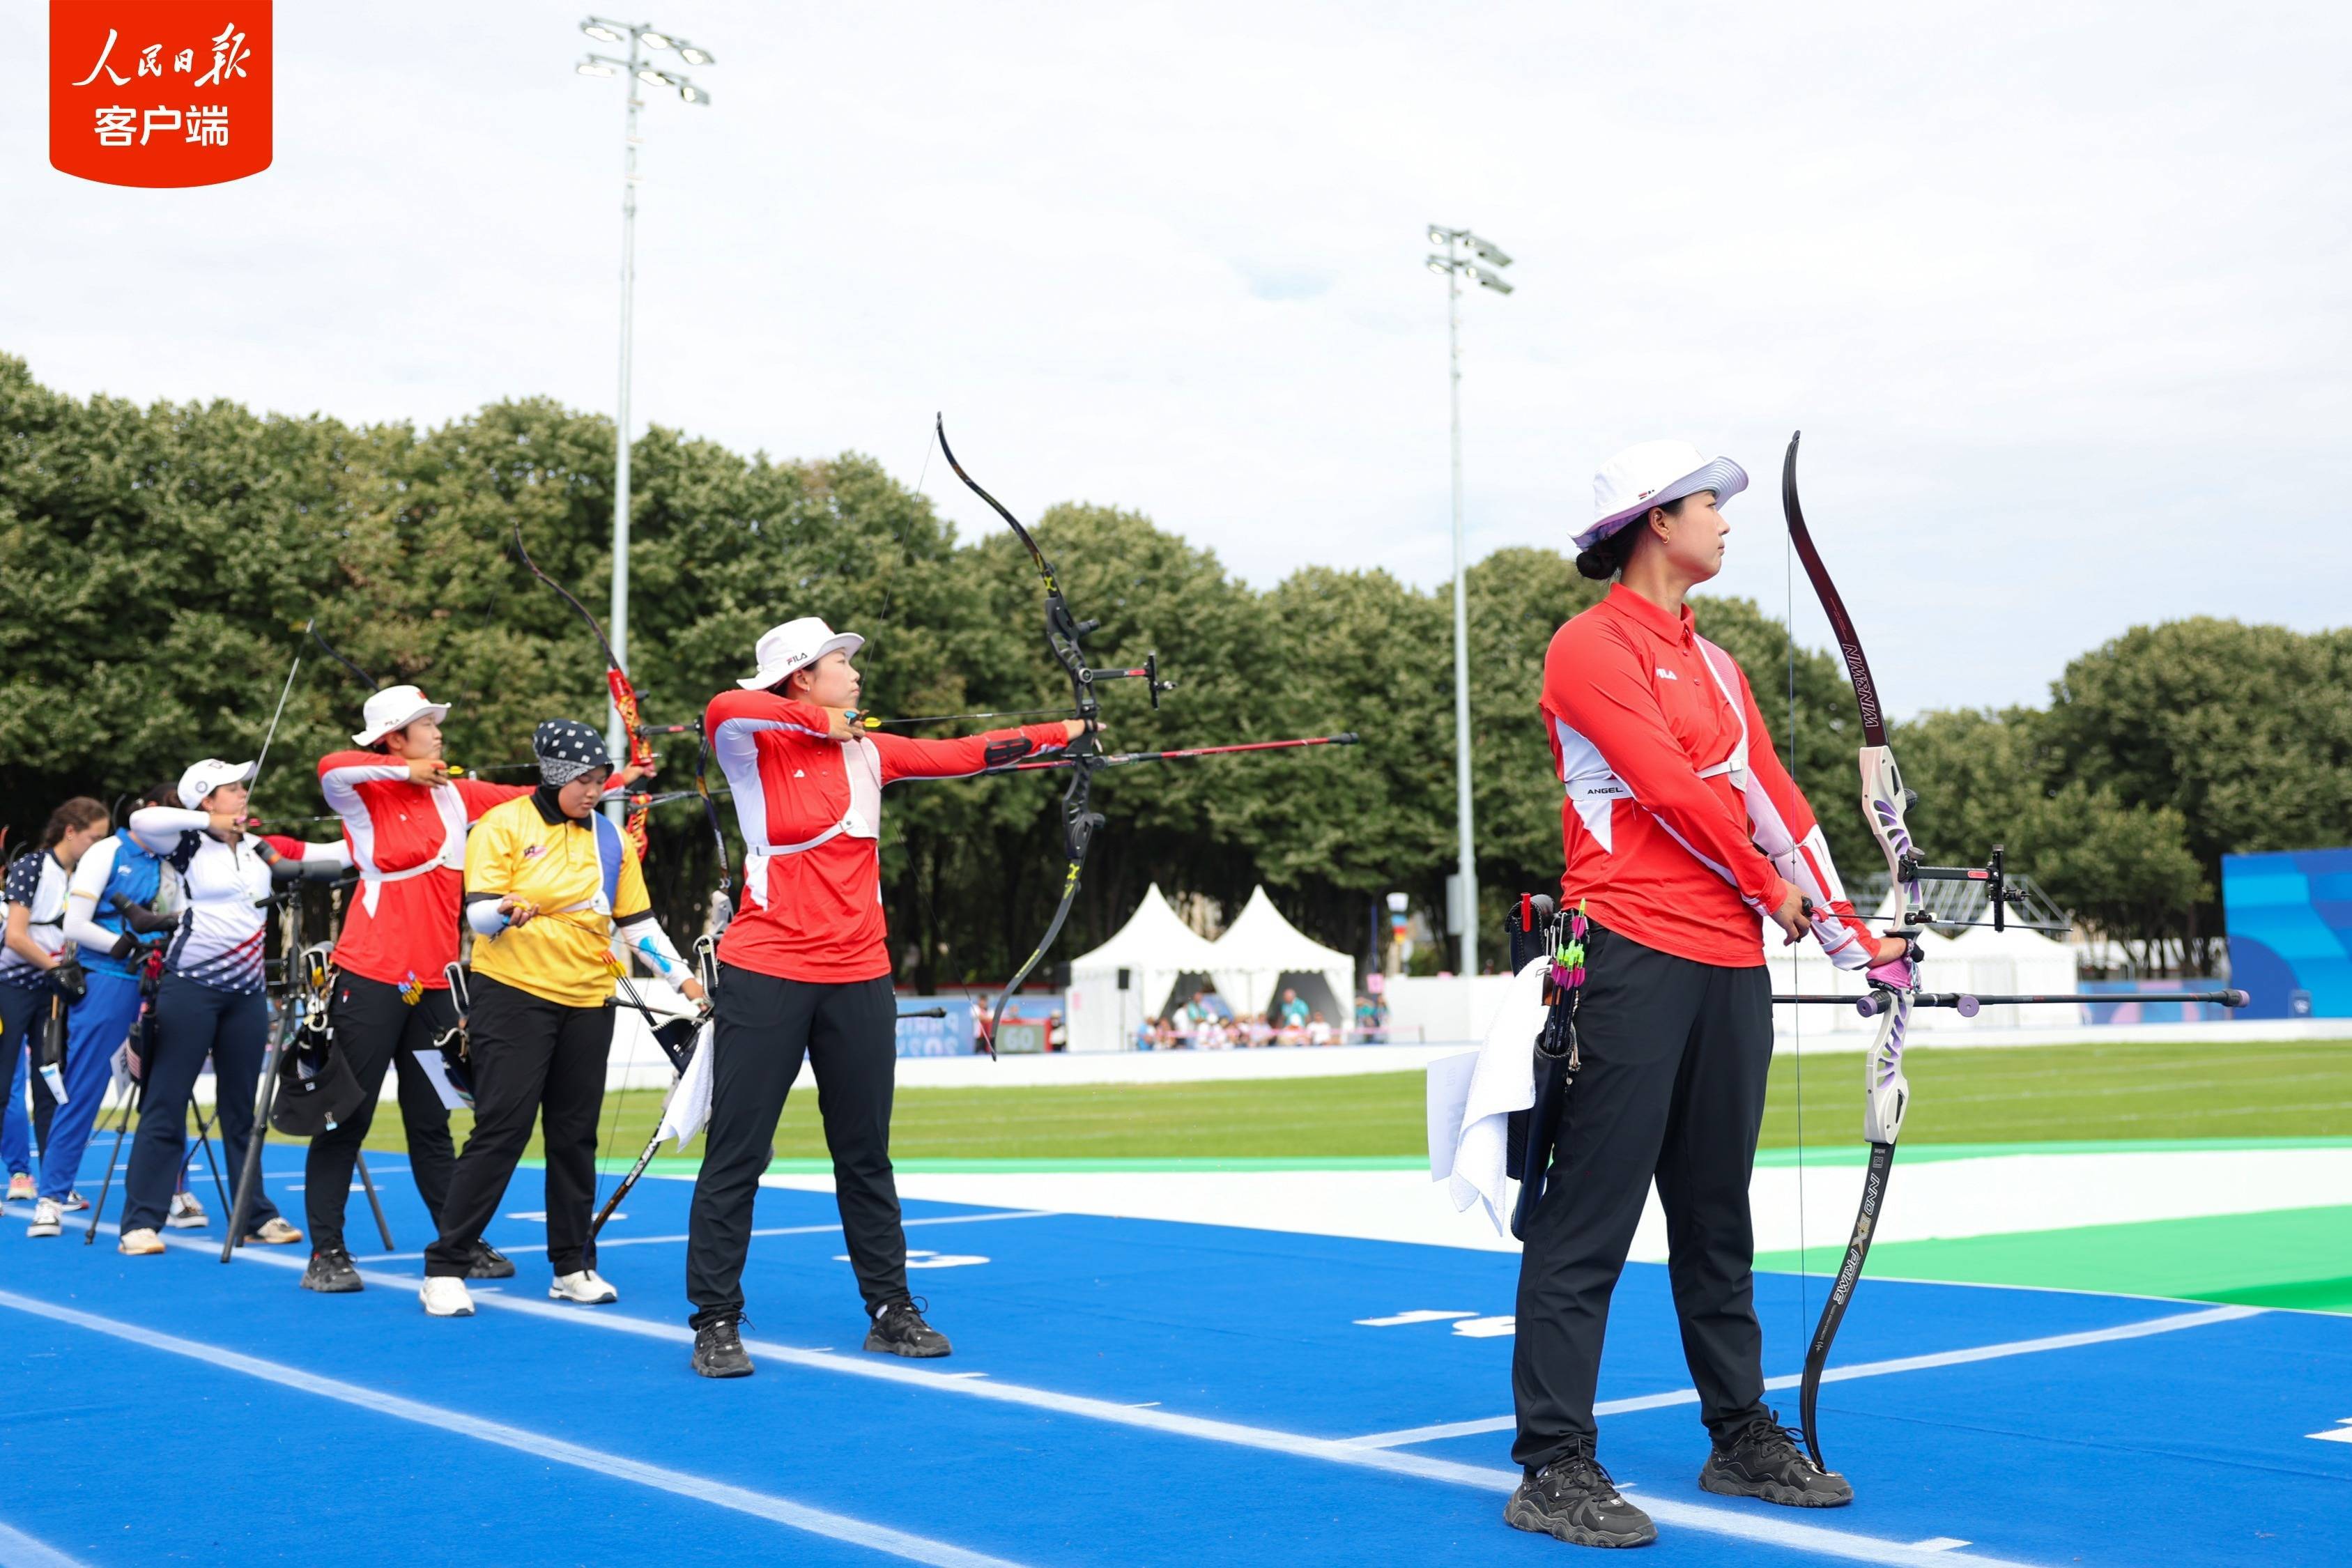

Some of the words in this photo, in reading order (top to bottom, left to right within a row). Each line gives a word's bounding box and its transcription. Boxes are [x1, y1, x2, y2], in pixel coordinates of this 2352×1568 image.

[786, 652, 808, 666] FILA
[1842, 643, 1879, 728] WIN&WIN
[1863, 1173, 1880, 1215] INNO
[1833, 1248, 1860, 1305] PRIME
